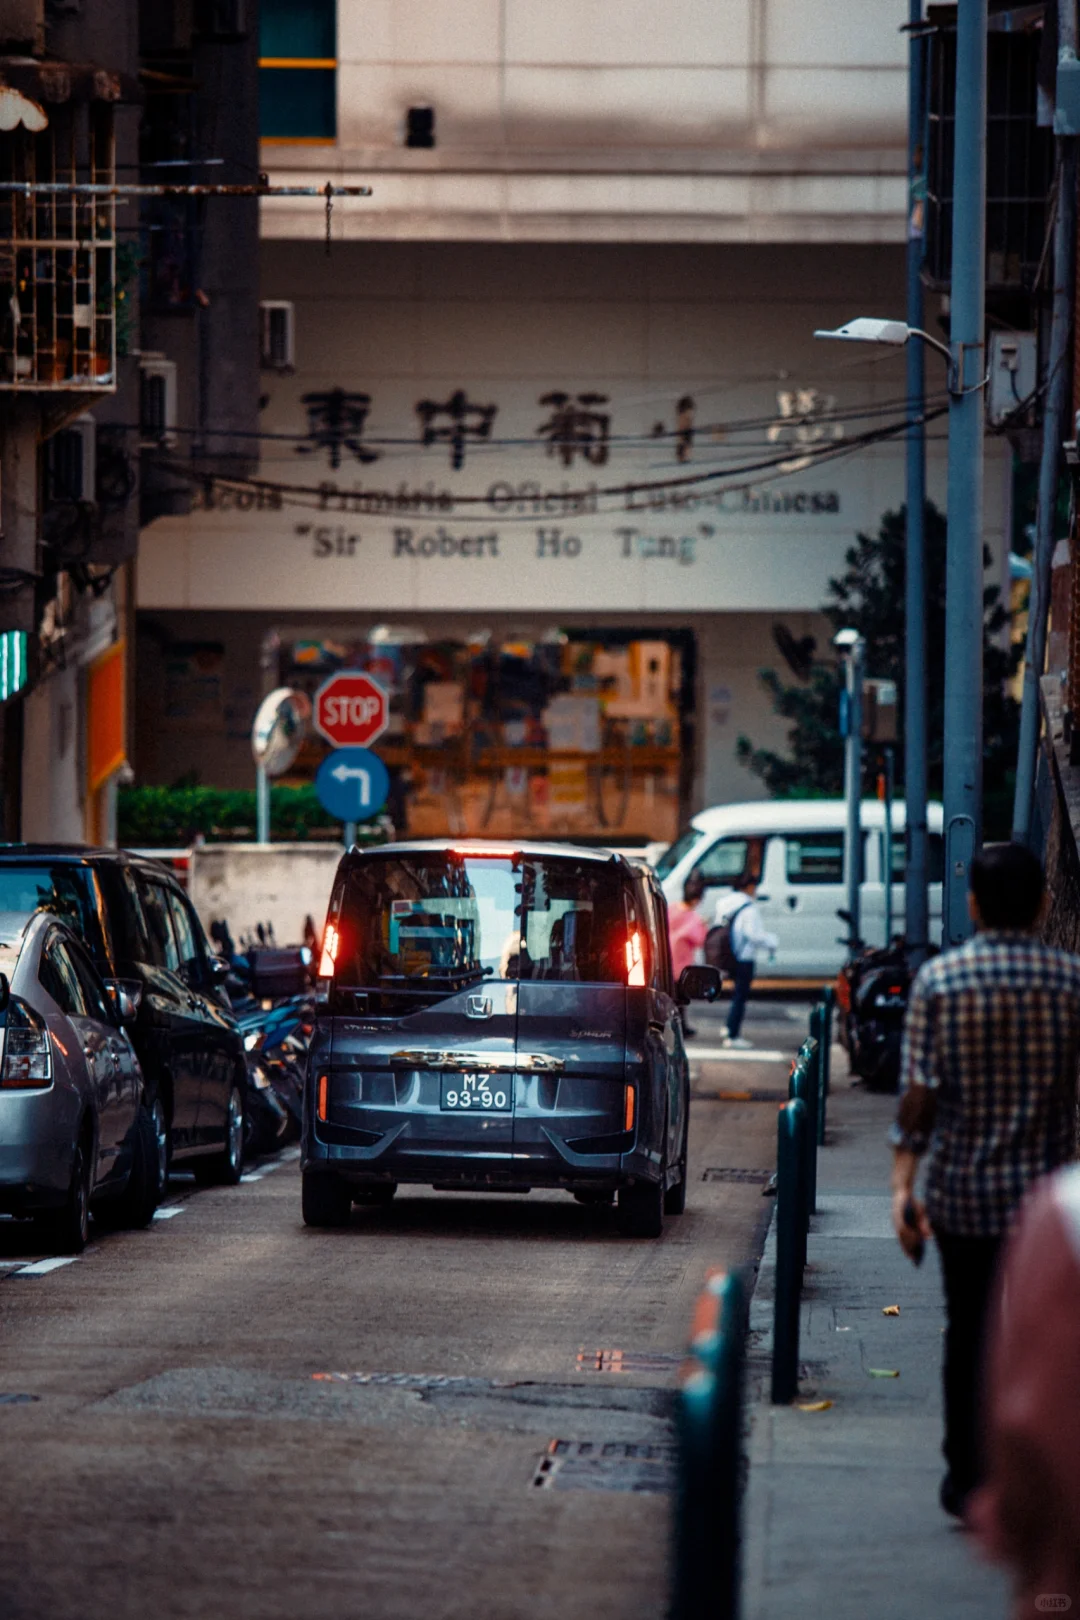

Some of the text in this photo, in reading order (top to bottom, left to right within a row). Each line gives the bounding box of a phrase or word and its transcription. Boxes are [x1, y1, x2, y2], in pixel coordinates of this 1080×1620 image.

[393, 526, 500, 558] Robert
[536, 527, 582, 558] Ho
[323, 696, 380, 726] STOP
[463, 1074, 489, 1091] MZ
[446, 1091, 507, 1109] 93-90
